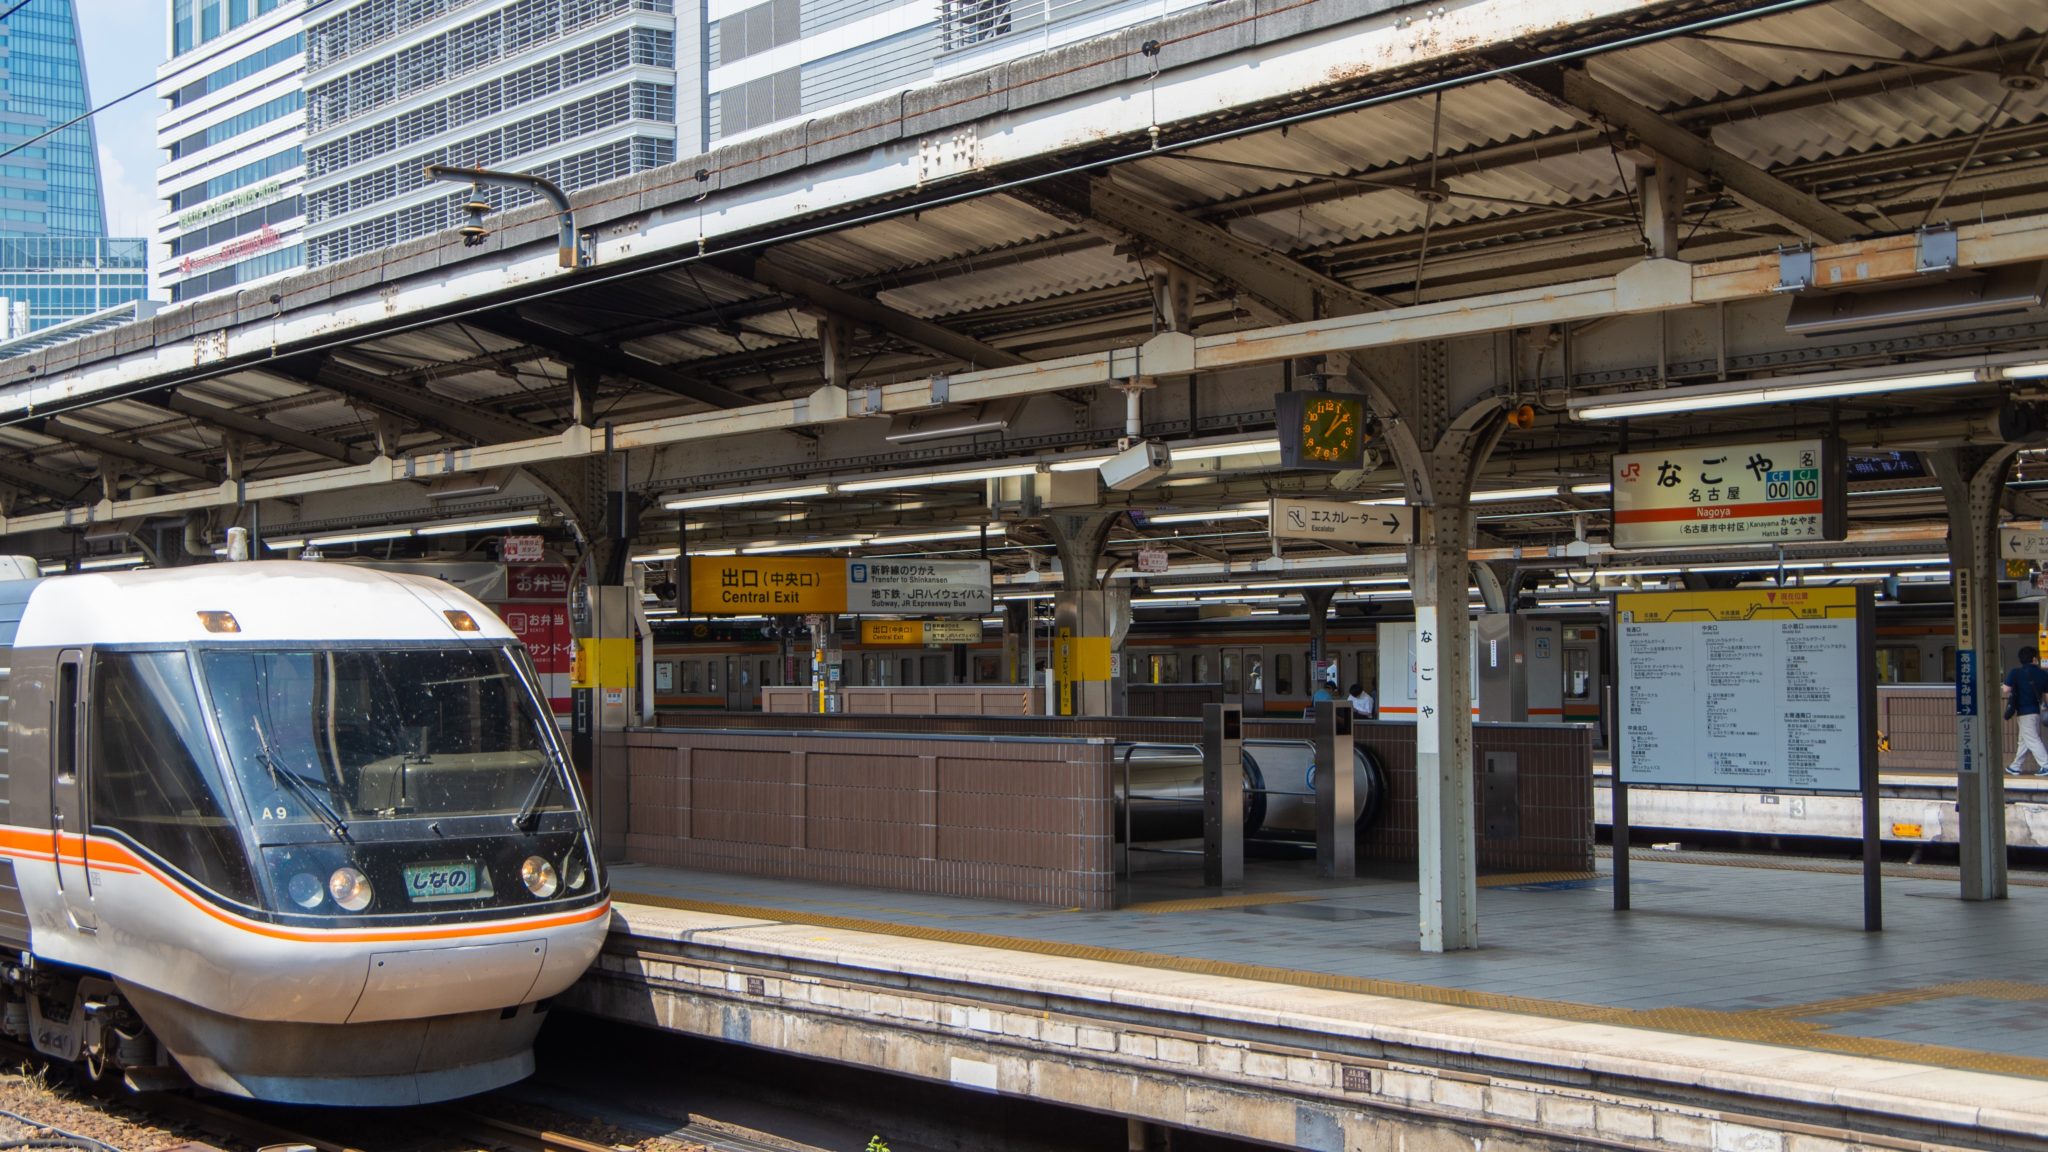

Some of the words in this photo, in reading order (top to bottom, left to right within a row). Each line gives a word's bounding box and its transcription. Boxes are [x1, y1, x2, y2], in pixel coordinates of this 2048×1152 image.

[1325, 402, 1334, 411] 12
[1309, 413, 1318, 421] 10
[1304, 425, 1311, 433] 9
[1345, 427, 1352, 435] 3
[1308, 438, 1314, 446] 8
[1340, 440, 1347, 448] 4
[1332, 448, 1338, 456] 5
[1802, 452, 1814, 467] 名
[1620, 463, 1640, 478] JR
[1656, 453, 1774, 487] なごや
[1771, 471, 1784, 481] CF
[1799, 470, 1812, 480] CJ
[1412, 468, 1423, 496] 6
[1794, 480, 1816, 496] 00
[1689, 486, 1741, 502] 名古屋
[1768, 482, 1789, 498] 00
[1311, 510, 1379, 525] エスカレーター
[1696, 507, 1731, 519] Nagoya
[1679, 520, 1750, 535] (名古屋市中村区)
[1750, 519, 1780, 528] Kanayama
[1781, 516, 1817, 527] かなやま
[1311, 525, 1335, 533] Escalator
[1781, 527, 1816, 537] はった
[871, 565, 935, 576] 新幹線のりかえ
[516, 574, 567, 592] お弁当
[722, 568, 821, 588] 出口(中央口)
[871, 576, 901, 584] Transfer
[902, 576, 908, 584] to
[909, 576, 948, 584] Shinkansen
[722, 590, 770, 604] Central
[774, 590, 800, 604] Exit
[871, 588, 985, 600] 地下鉄・JRハイウェイバス
[871, 600, 900, 608] Subway,
[901, 600, 911, 608] JR
[912, 600, 951, 608] Expressway
[953, 600, 967, 608] Bus
[529, 614, 564, 626] お弁当
[1420, 629, 1434, 719] なごや
[1960, 653, 1971, 706] あおなみ線
[262, 806, 288, 820] A9
[1793, 799, 1804, 817] 3
[412, 870, 467, 889] しなの
